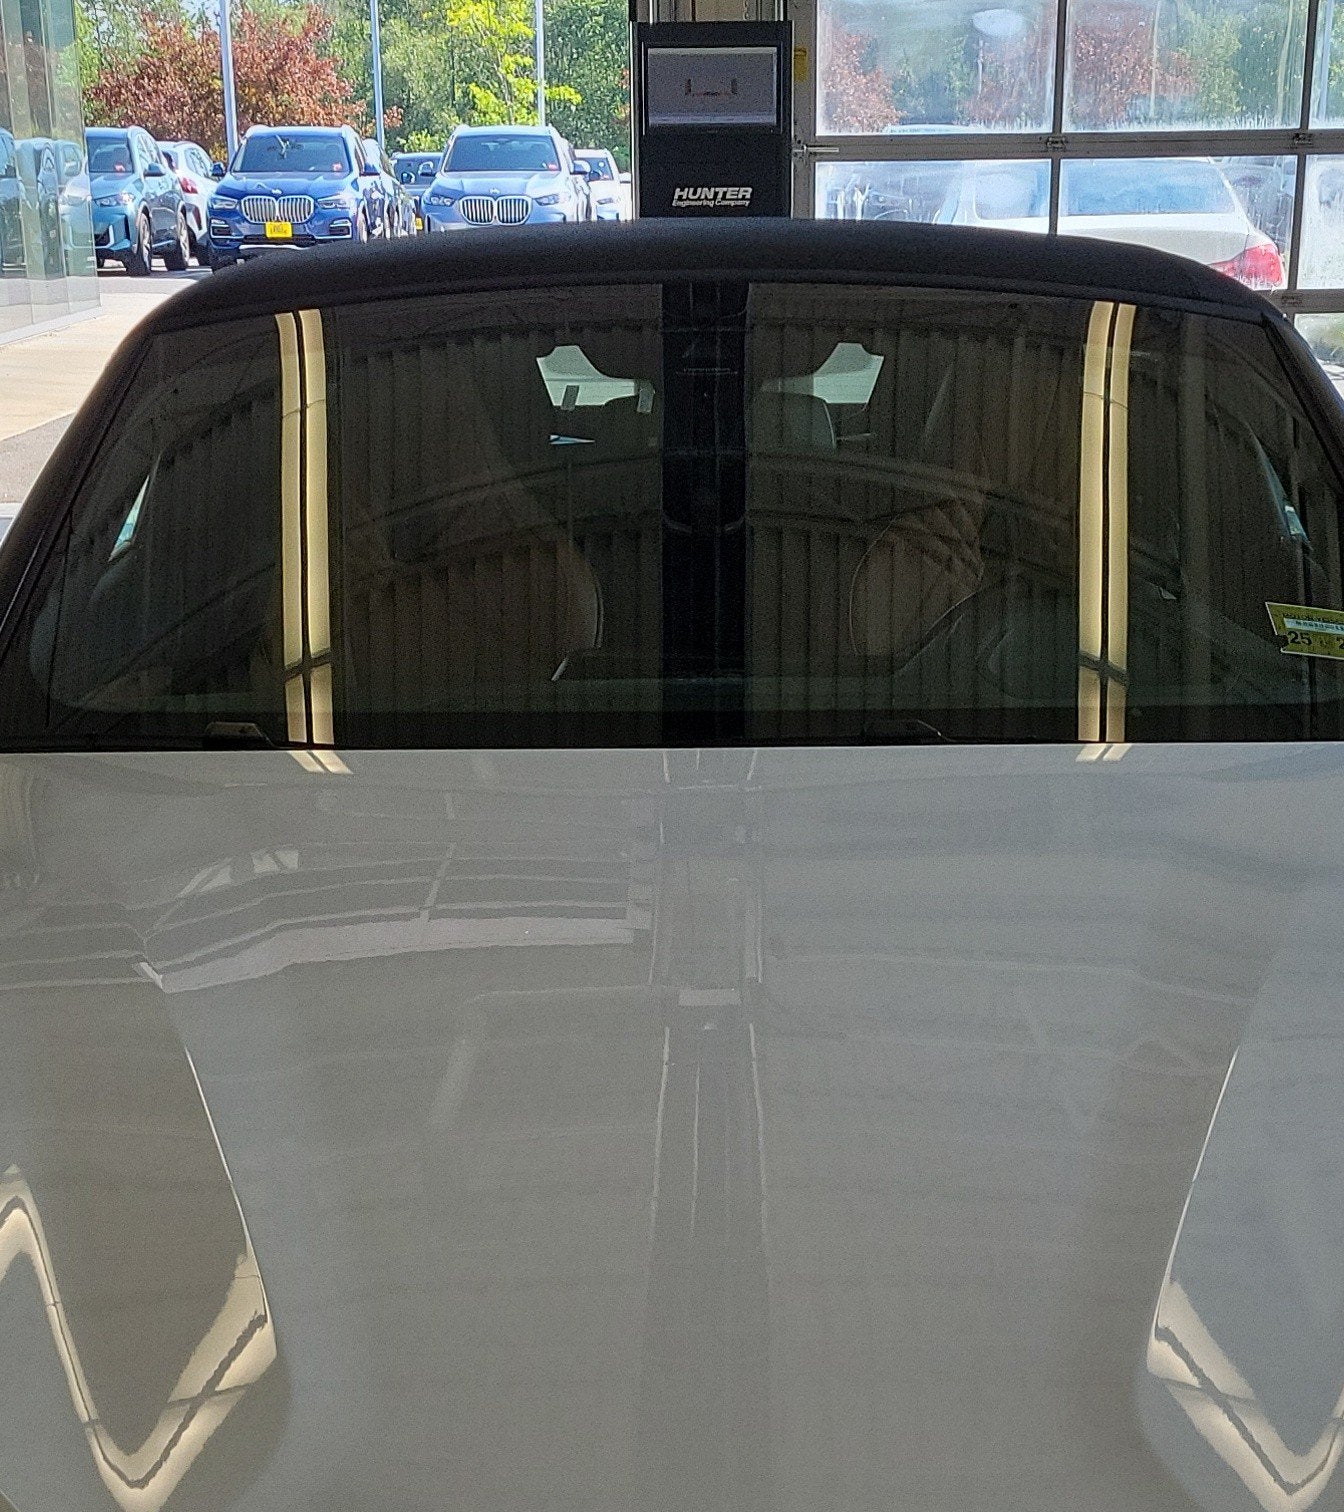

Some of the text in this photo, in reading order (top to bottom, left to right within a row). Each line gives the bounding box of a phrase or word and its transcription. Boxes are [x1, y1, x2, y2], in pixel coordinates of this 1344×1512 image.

[674, 187, 753, 200] HUNTER
[715, 199, 750, 207] Company
[1287, 630, 1313, 646] 25
